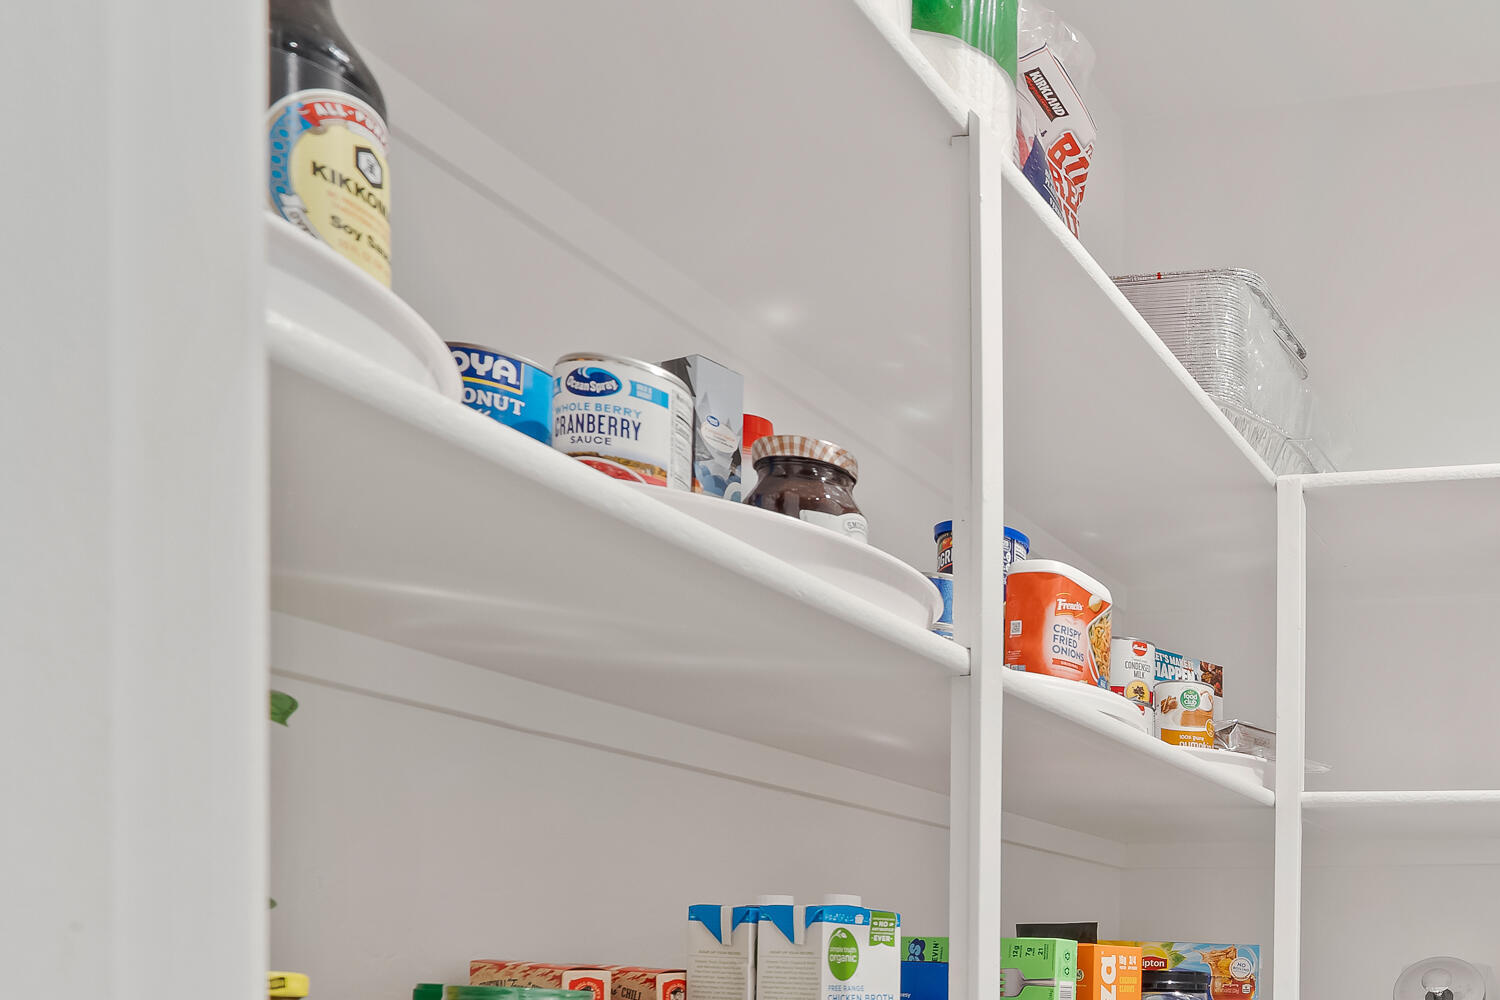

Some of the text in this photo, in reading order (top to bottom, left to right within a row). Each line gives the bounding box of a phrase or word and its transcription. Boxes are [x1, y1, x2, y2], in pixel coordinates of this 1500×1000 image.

[1029, 71, 1065, 117] KIRKLAND
[329, 214, 362, 242] Soy
[556, 402, 641, 418] WHOLE BERRY
[555, 413, 642, 441] CRANBERRY
[570, 435, 613, 446] SAUCE
[1053, 624, 1082, 640] CRISPY
[1053, 635, 1078, 649] FRIED
[1052, 645, 1085, 662] ONIONS
[878, 920, 889, 928] NO
